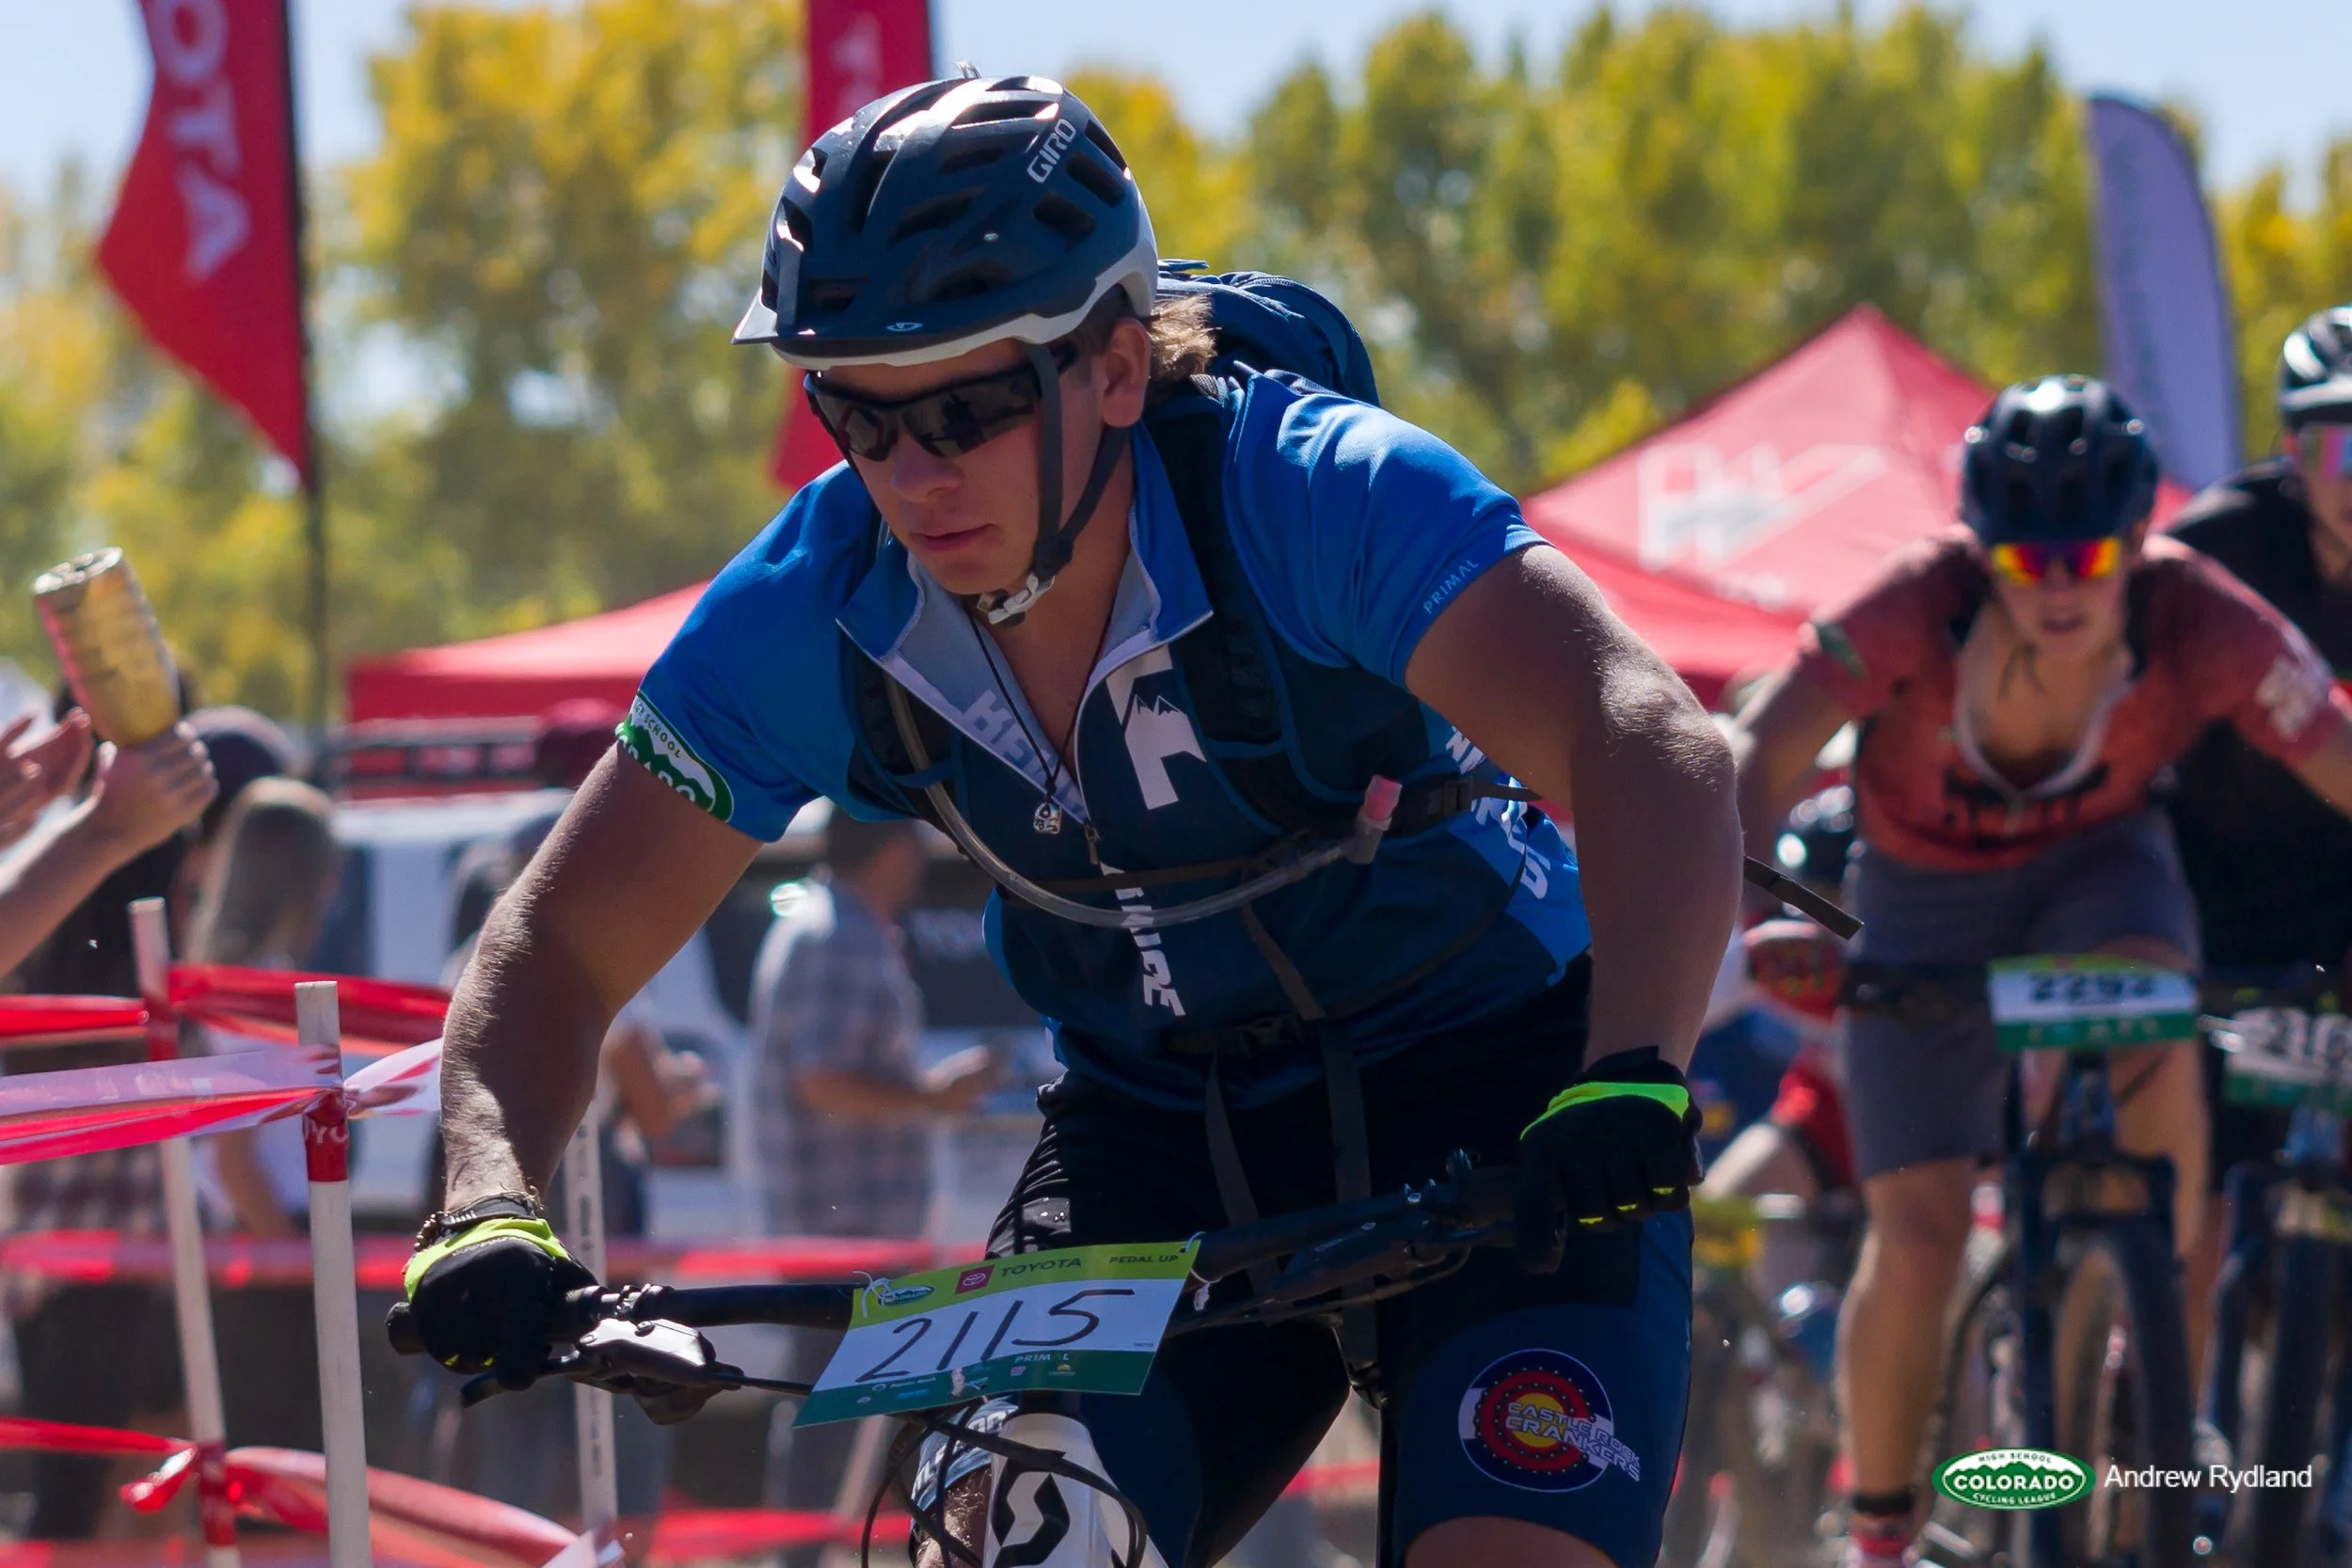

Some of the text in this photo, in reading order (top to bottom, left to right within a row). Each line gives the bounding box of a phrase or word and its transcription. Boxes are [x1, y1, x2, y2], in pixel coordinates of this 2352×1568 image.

[1027, 119, 1077, 183] GIRO
[1423, 559, 1480, 615] PRIMAL
[644, 713, 681, 759] SCHOOL
[1000, 1255, 1180, 1277] TOYOTA PEDAL UP
[856, 1288, 1135, 1382] 2115
[1014, 1352, 1070, 1364] PRIML
[1507, 1402, 1593, 1435] CASTLE
[1505, 1415, 1641, 1482] CRANKERS
